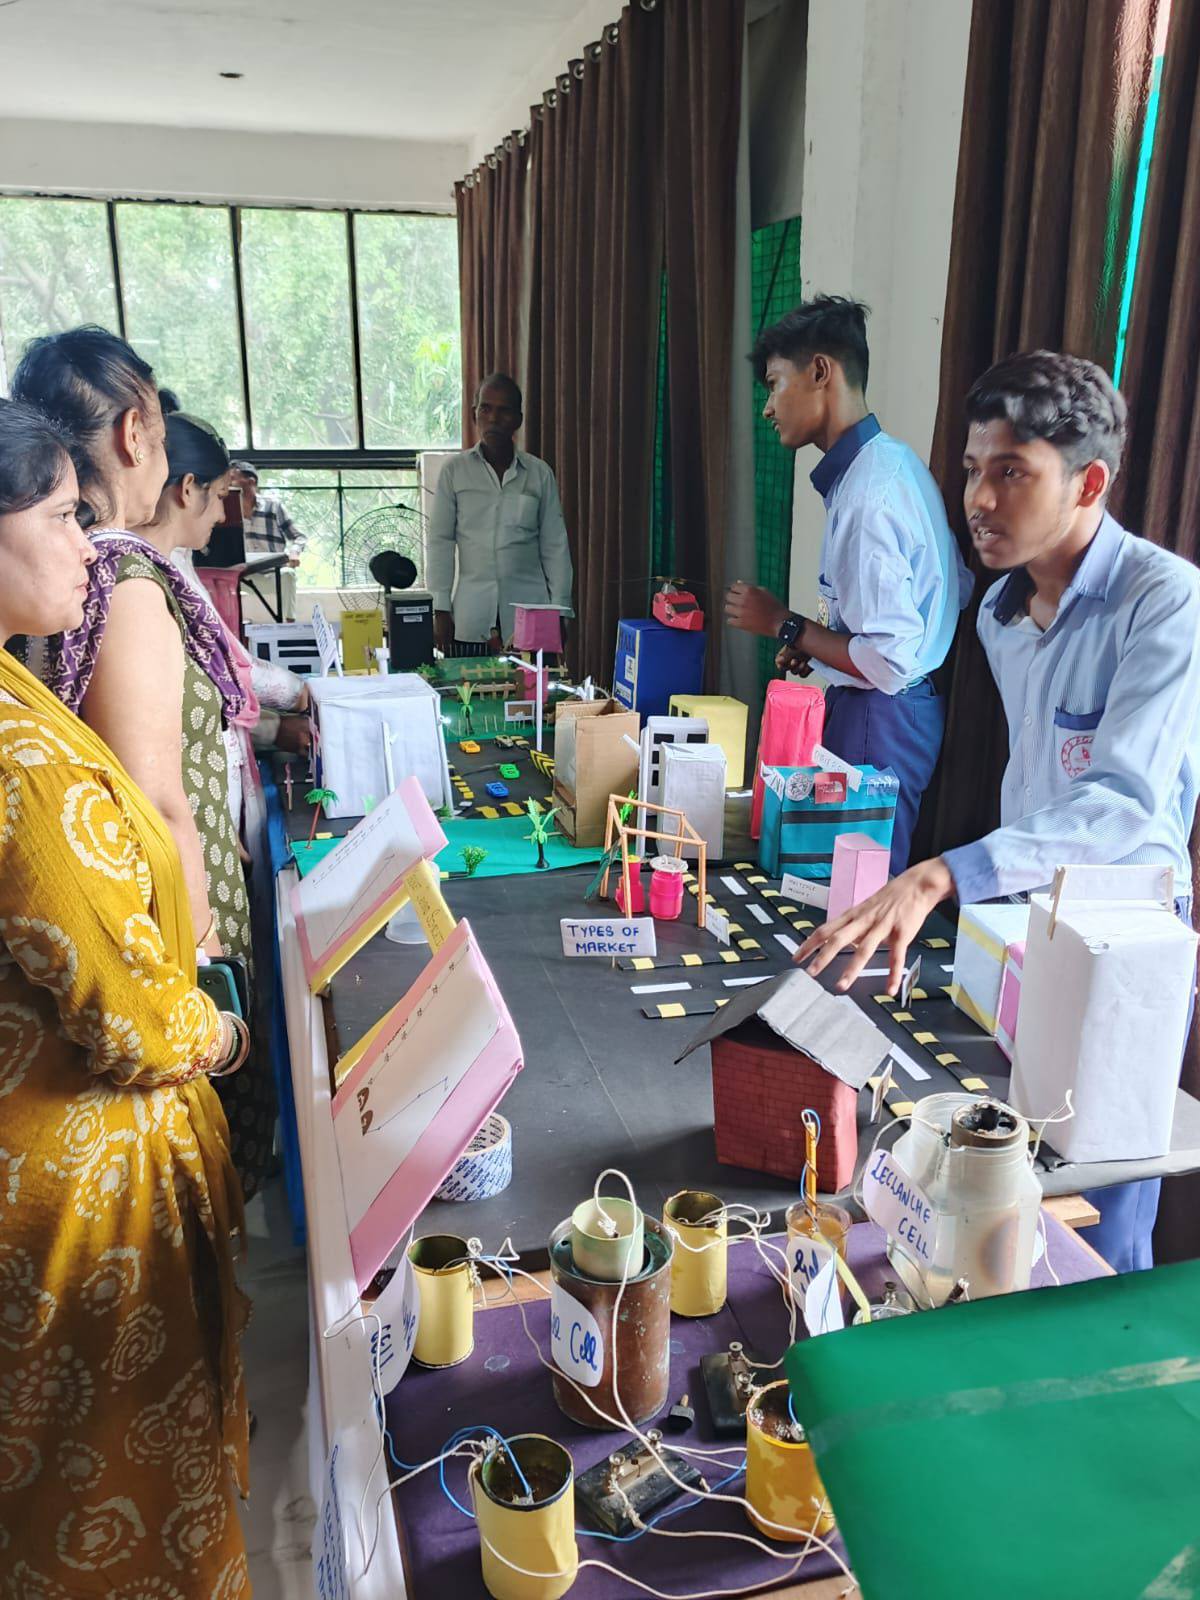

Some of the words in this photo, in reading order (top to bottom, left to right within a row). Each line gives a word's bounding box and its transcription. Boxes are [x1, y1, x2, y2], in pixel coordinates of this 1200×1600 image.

[567, 925, 614, 938] TYPES
[622, 926, 640, 938] OF
[576, 941, 637, 954] MARKET
[898, 1217, 929, 1259] CELL
[570, 1321, 598, 1372] Cell
